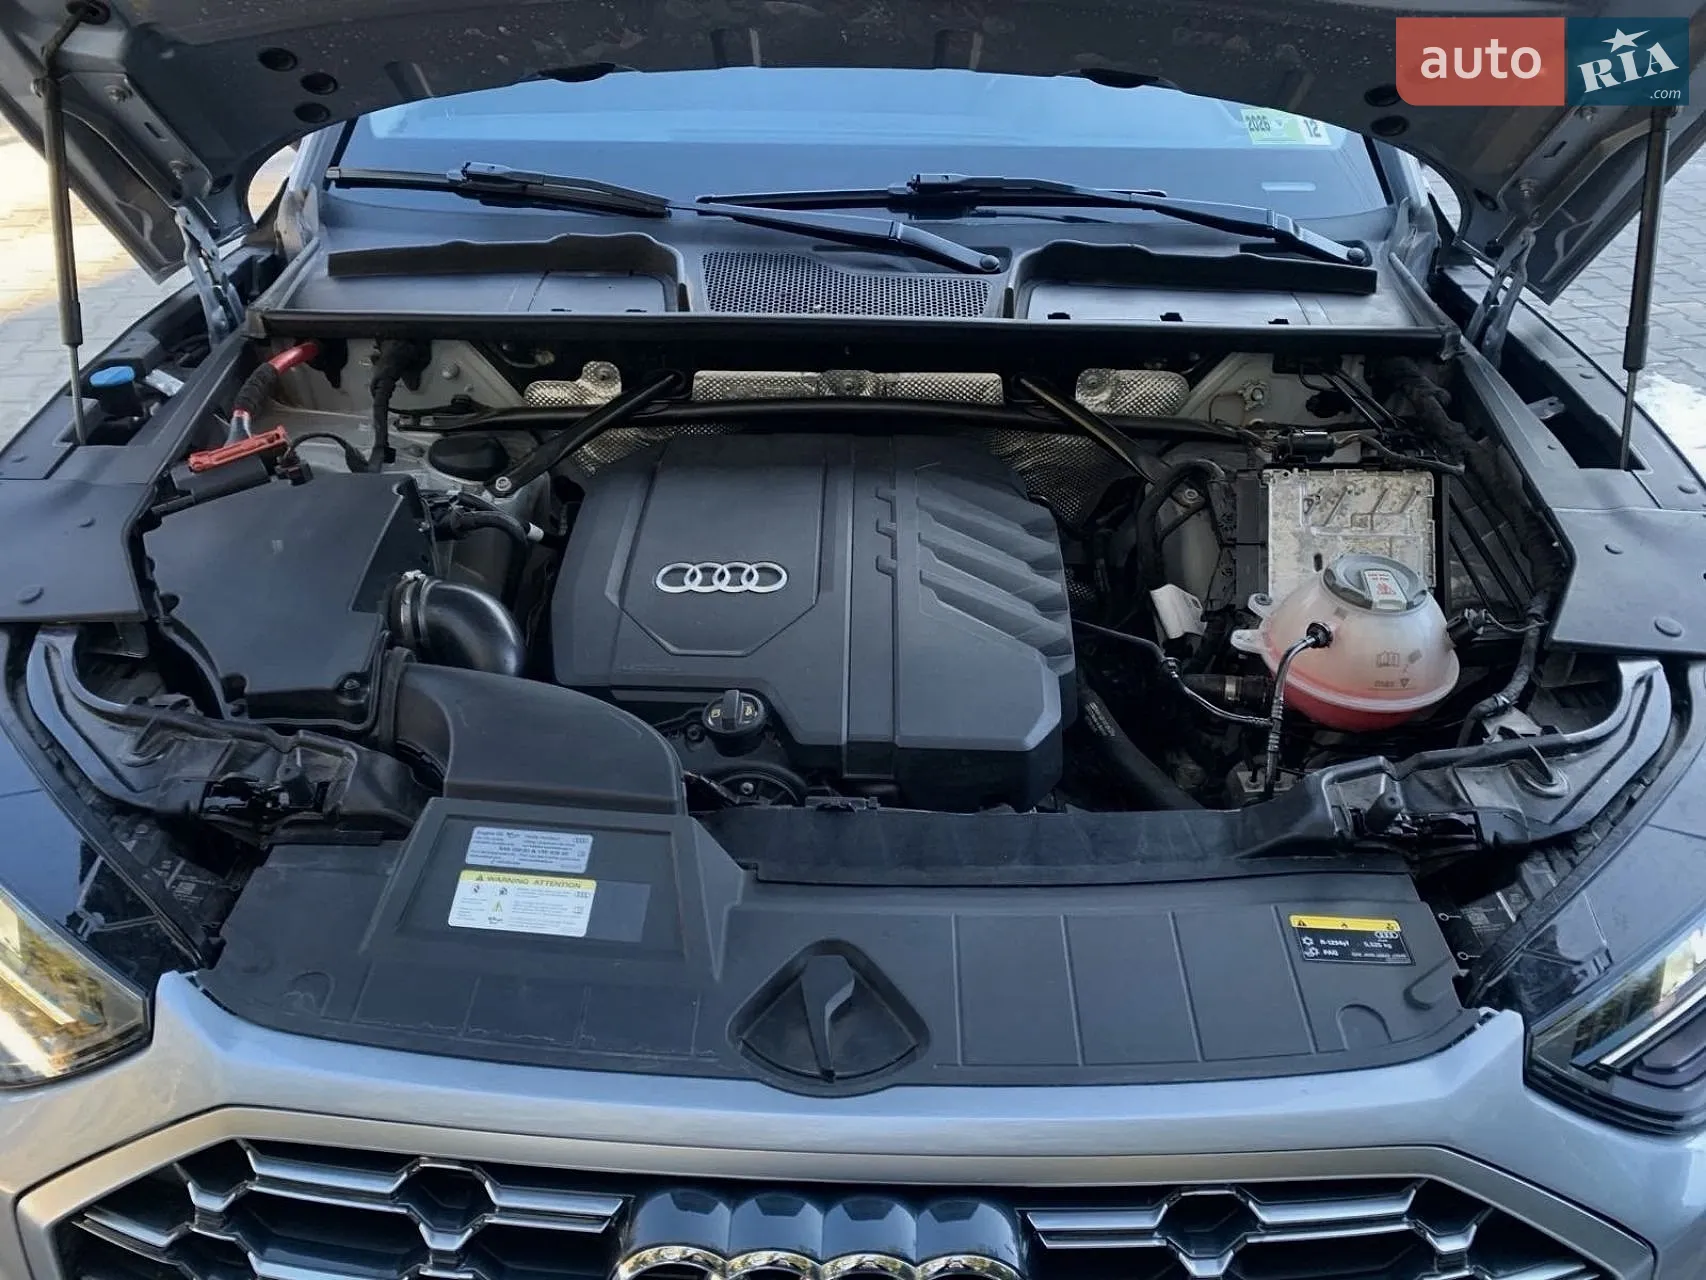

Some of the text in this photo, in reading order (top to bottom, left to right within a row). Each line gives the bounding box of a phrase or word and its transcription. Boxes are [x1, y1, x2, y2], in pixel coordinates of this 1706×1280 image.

[1303, 118, 1322, 138] 12
[486, 876, 582, 889] WARNING ATTENTION
